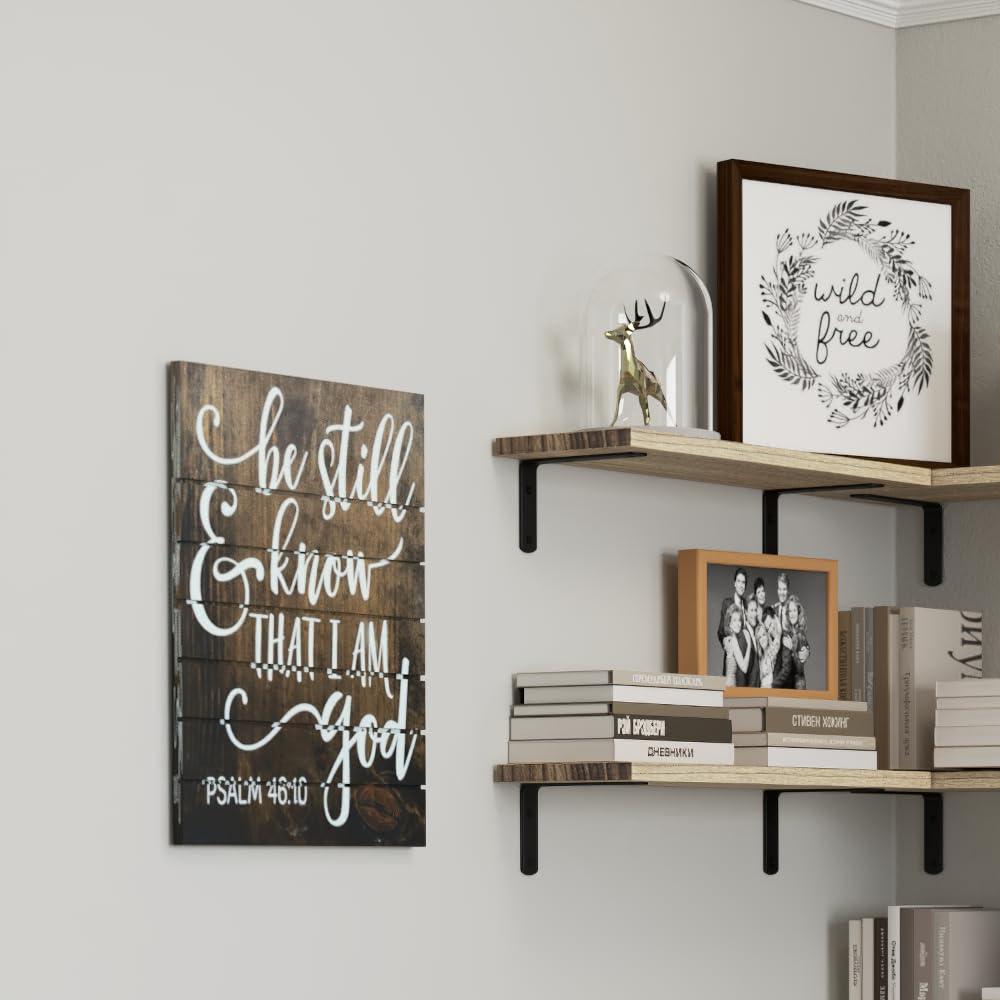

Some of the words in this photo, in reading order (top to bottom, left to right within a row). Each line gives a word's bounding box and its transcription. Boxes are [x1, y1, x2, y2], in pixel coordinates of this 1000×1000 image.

[814, 272, 885, 307] wild
[836, 310, 865, 324] and
[815, 310, 881, 365] free
[196, 386, 308, 496] be
[318, 404, 417, 523] still
[267, 497, 404, 605] know
[248, 613, 321, 682] THAT
[329, 619, 341, 680] I
[348, 619, 394, 699] AM
[617, 715, 631, 735] РЭЙ
[791, 714, 820, 728] СТИВЕН
[647, 746, 694, 758] ДНЕВНИКИ
[203, 776, 263, 806] PSALM
[266, 775, 309, 806] 46:10
